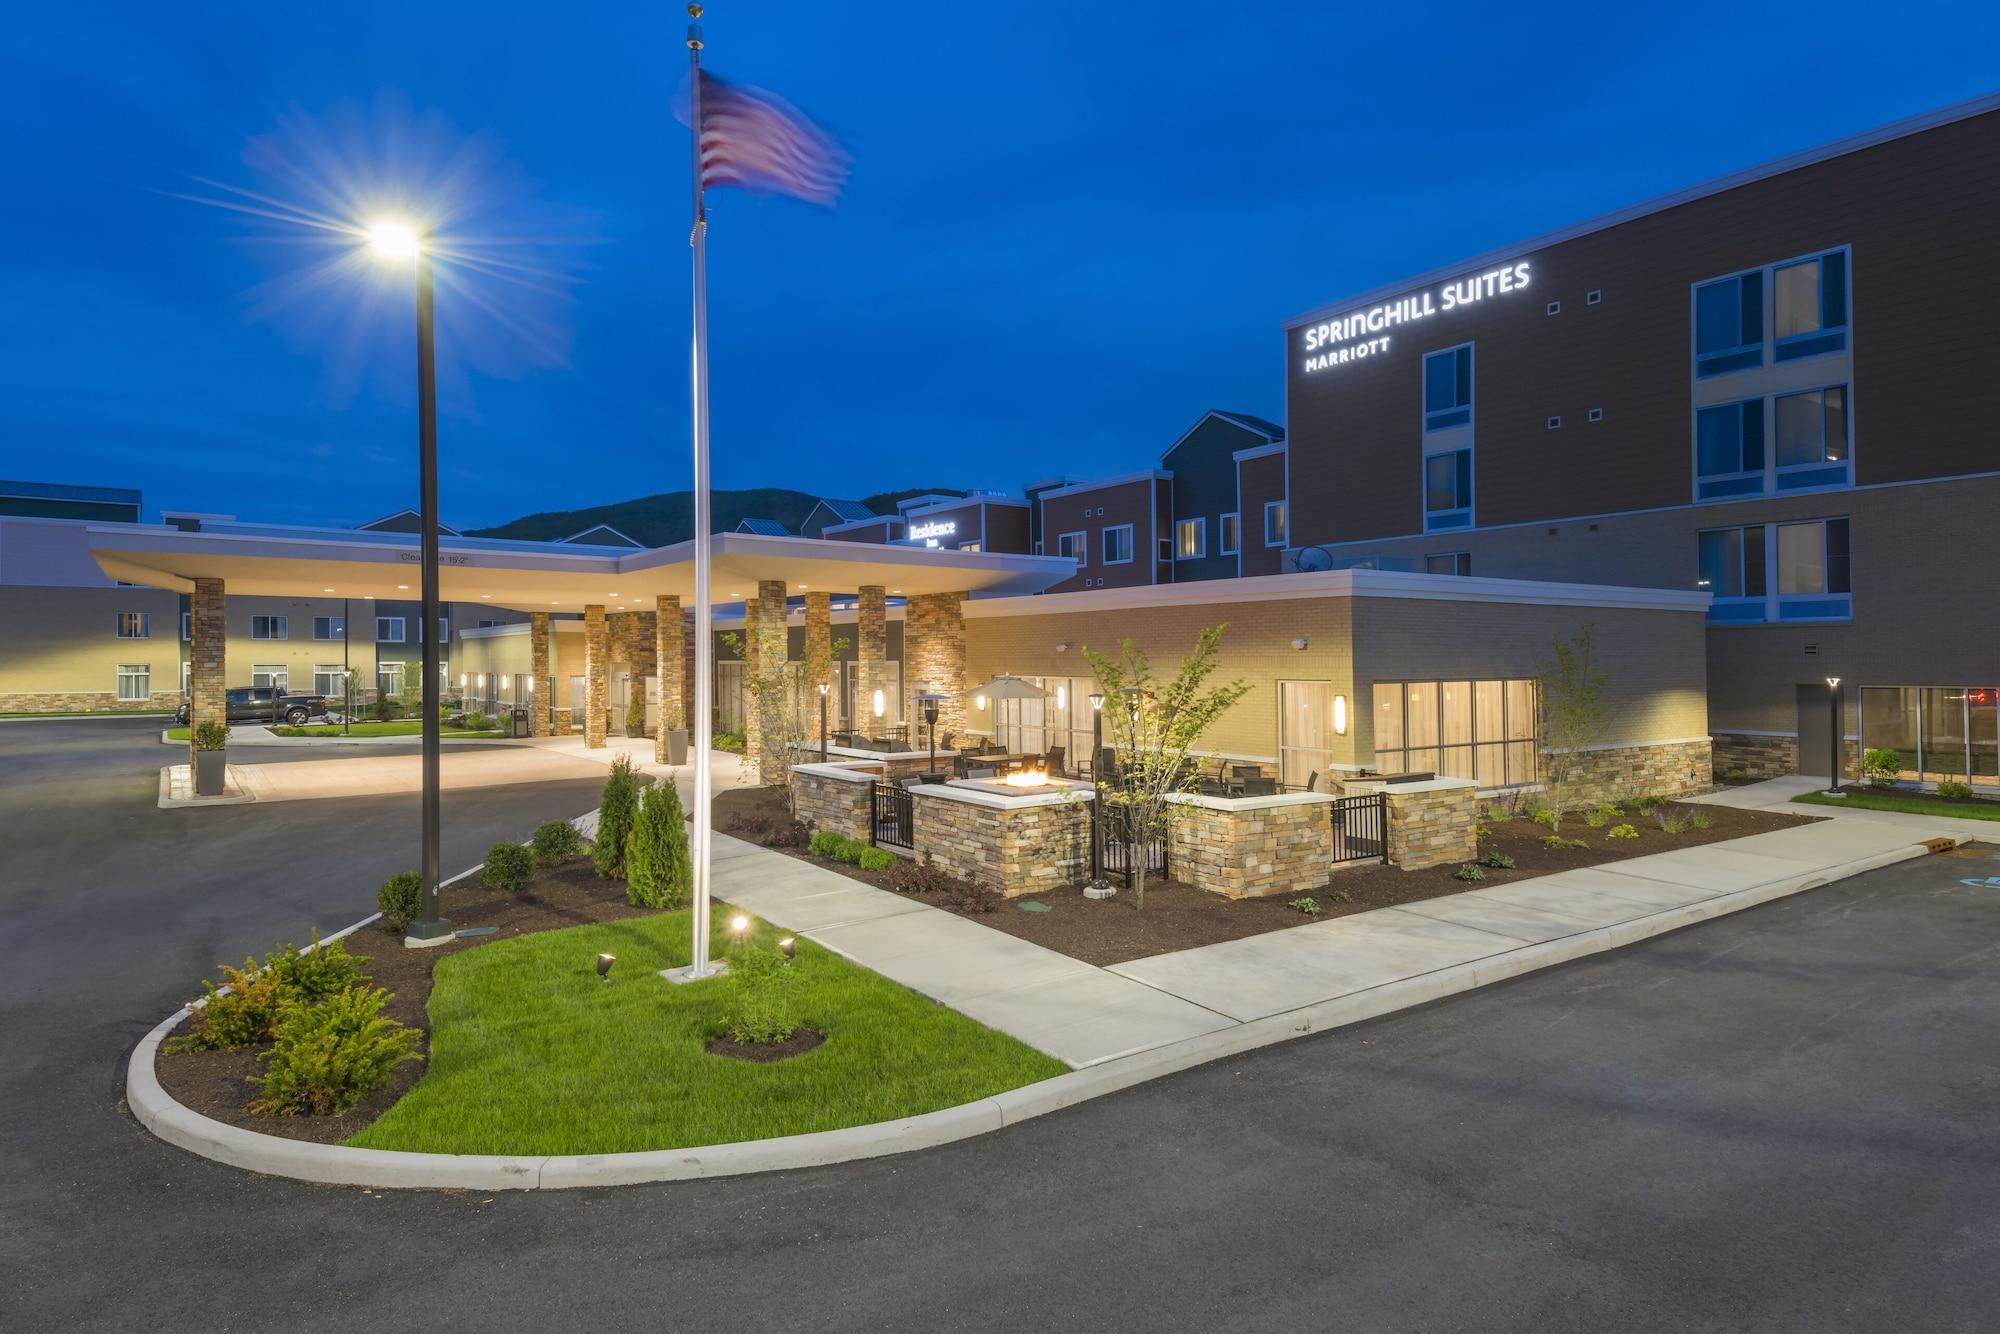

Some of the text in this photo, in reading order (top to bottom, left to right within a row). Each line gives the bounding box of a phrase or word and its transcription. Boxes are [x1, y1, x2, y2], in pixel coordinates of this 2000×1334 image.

[1305, 262, 1531, 351] SPRINGHILL SUITES
[1305, 337, 1390, 373] MARRIOTT
[909, 522, 956, 541] Residence
